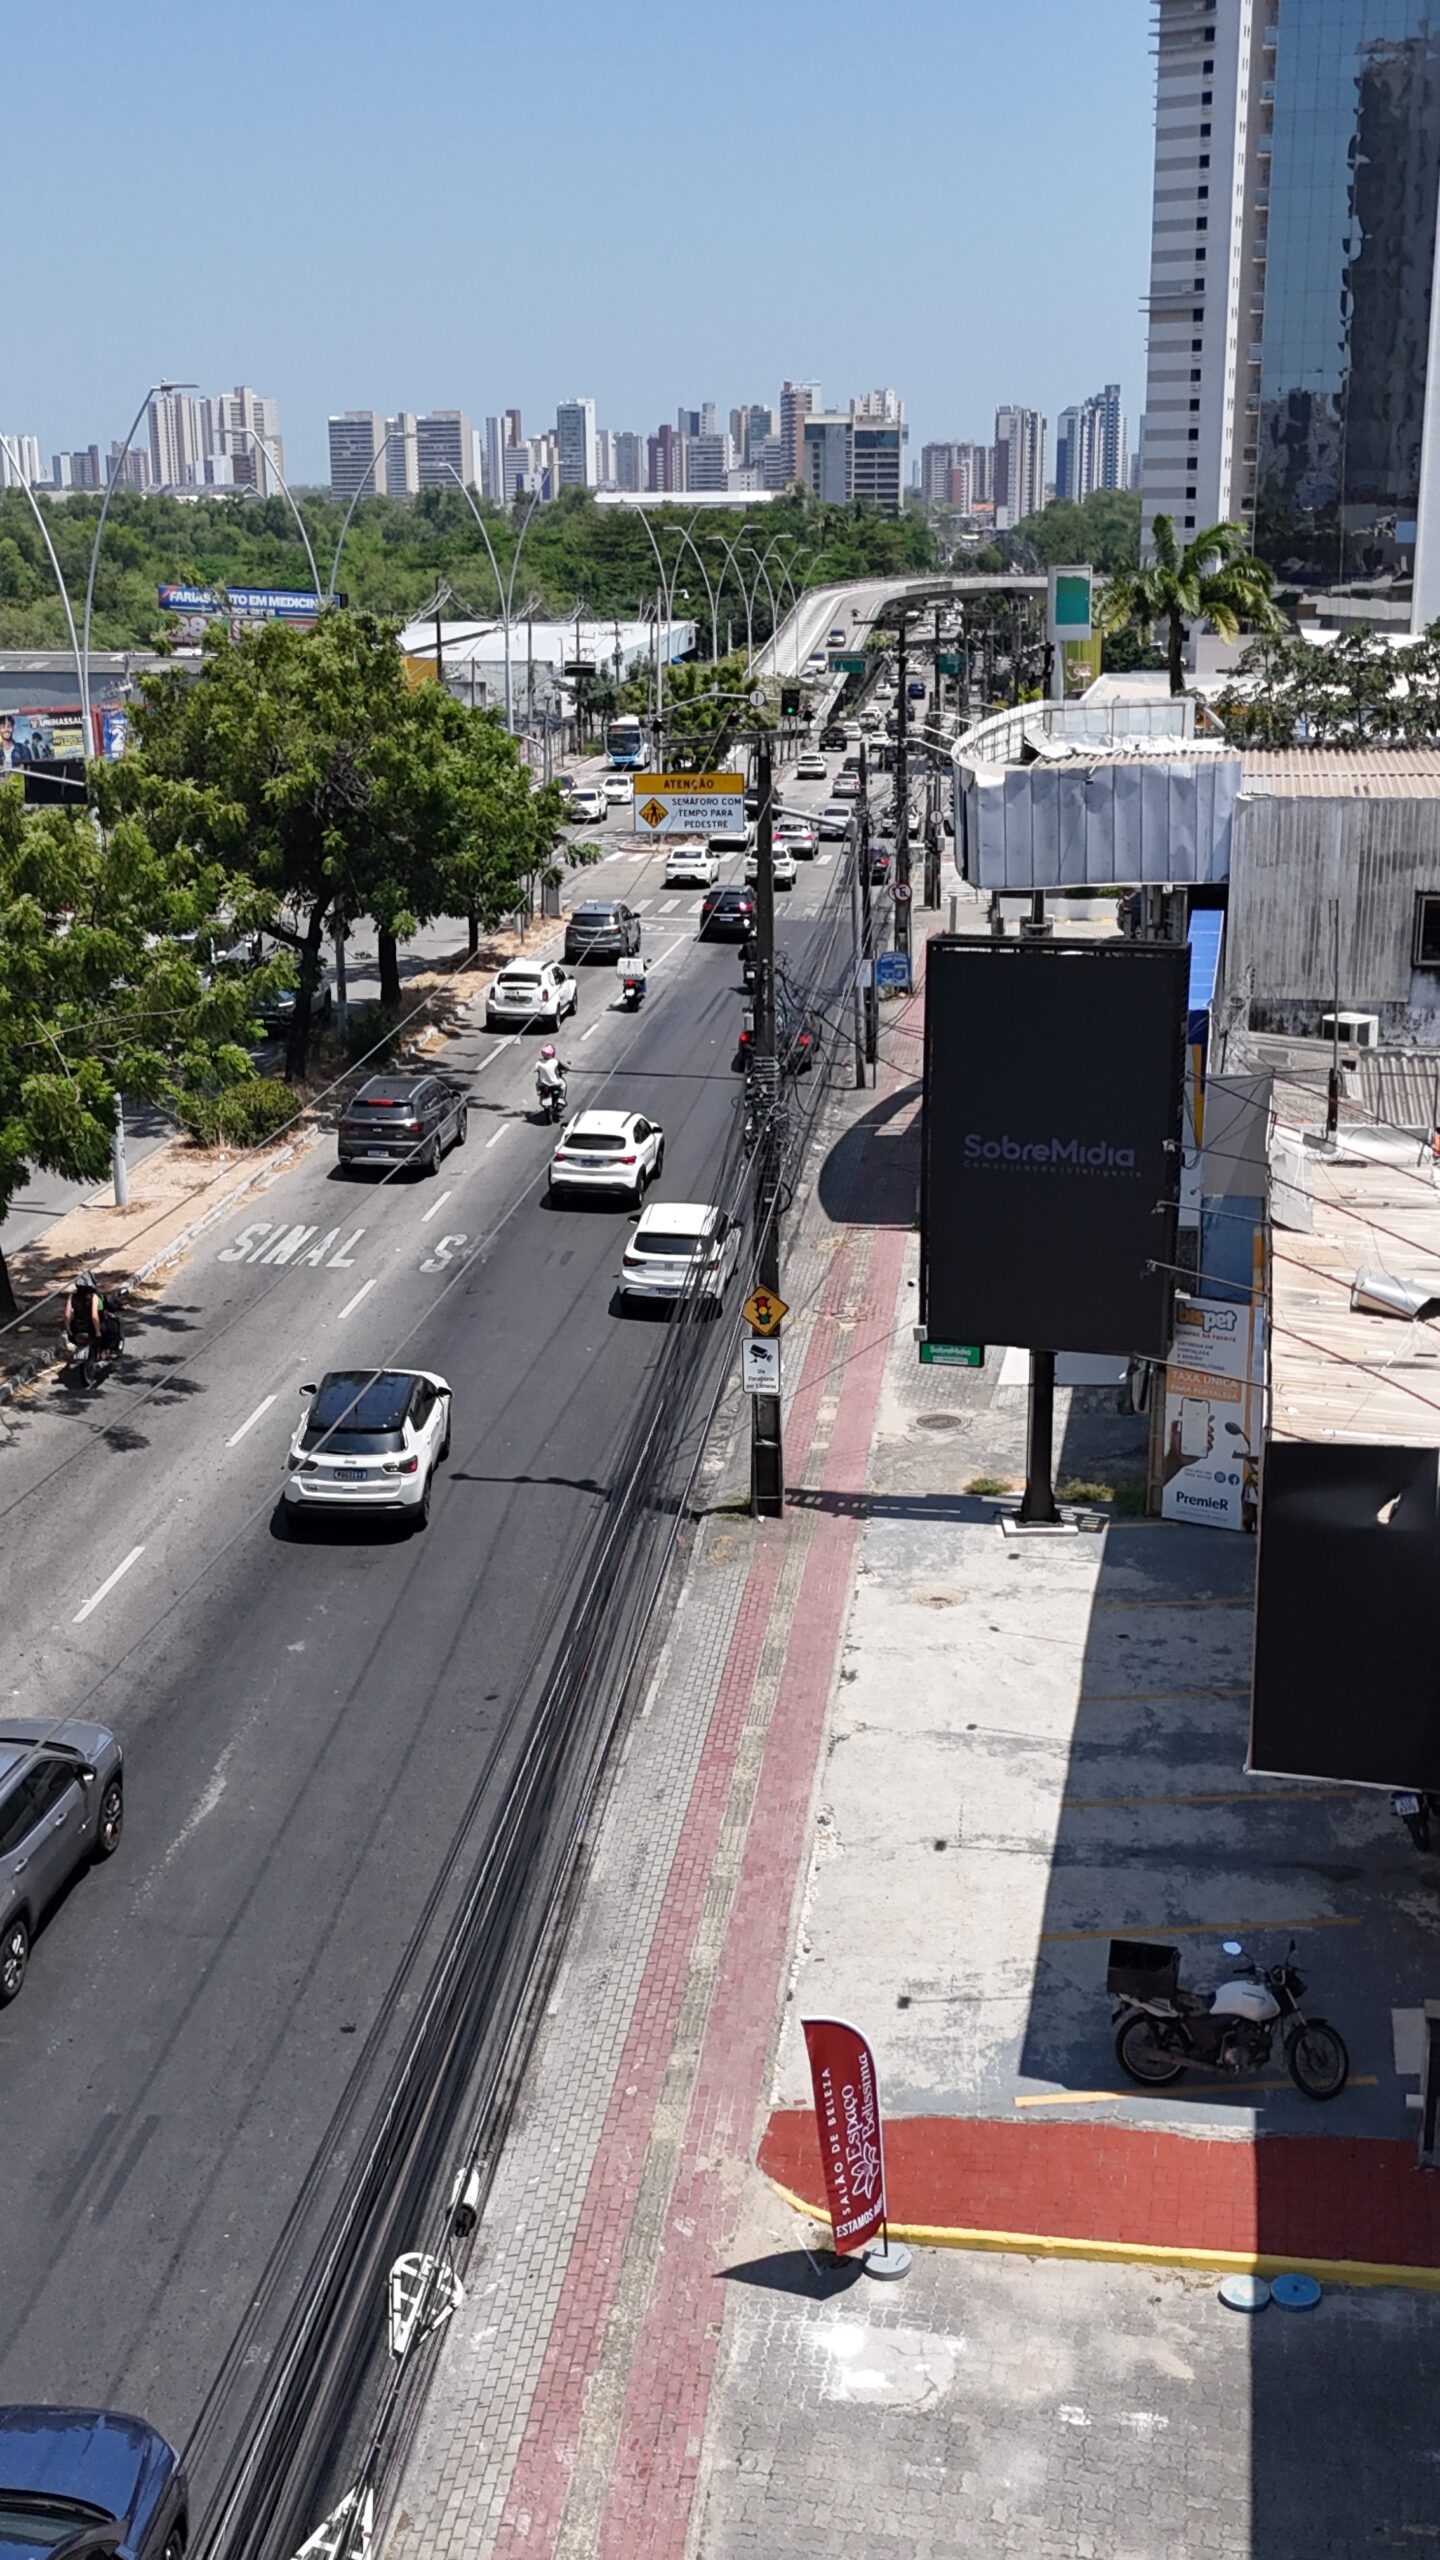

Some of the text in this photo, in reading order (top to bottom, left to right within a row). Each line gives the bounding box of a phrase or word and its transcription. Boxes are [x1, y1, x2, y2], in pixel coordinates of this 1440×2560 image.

[169, 590, 211, 603] FARIAS
[250, 595, 267, 606] EM
[269, 596, 323, 609] MEDICIN
[663, 779, 714, 790] ATENÇÃO
[721, 798, 741, 806] COM
[679, 809, 733, 817] TEMPO PARA
[684, 820, 728, 828] PEDESTRE
[216, 1222, 366, 1268] SINAL
[1171, 1370, 1201, 1384] TAXA
[1176, 1490, 1229, 1512] PremieR
[841, 2084, 863, 2163] Espaço
[821, 2067, 851, 2216] SALÃO DE BELEZA
[836, 2207, 874, 2238] ESTAMOS
